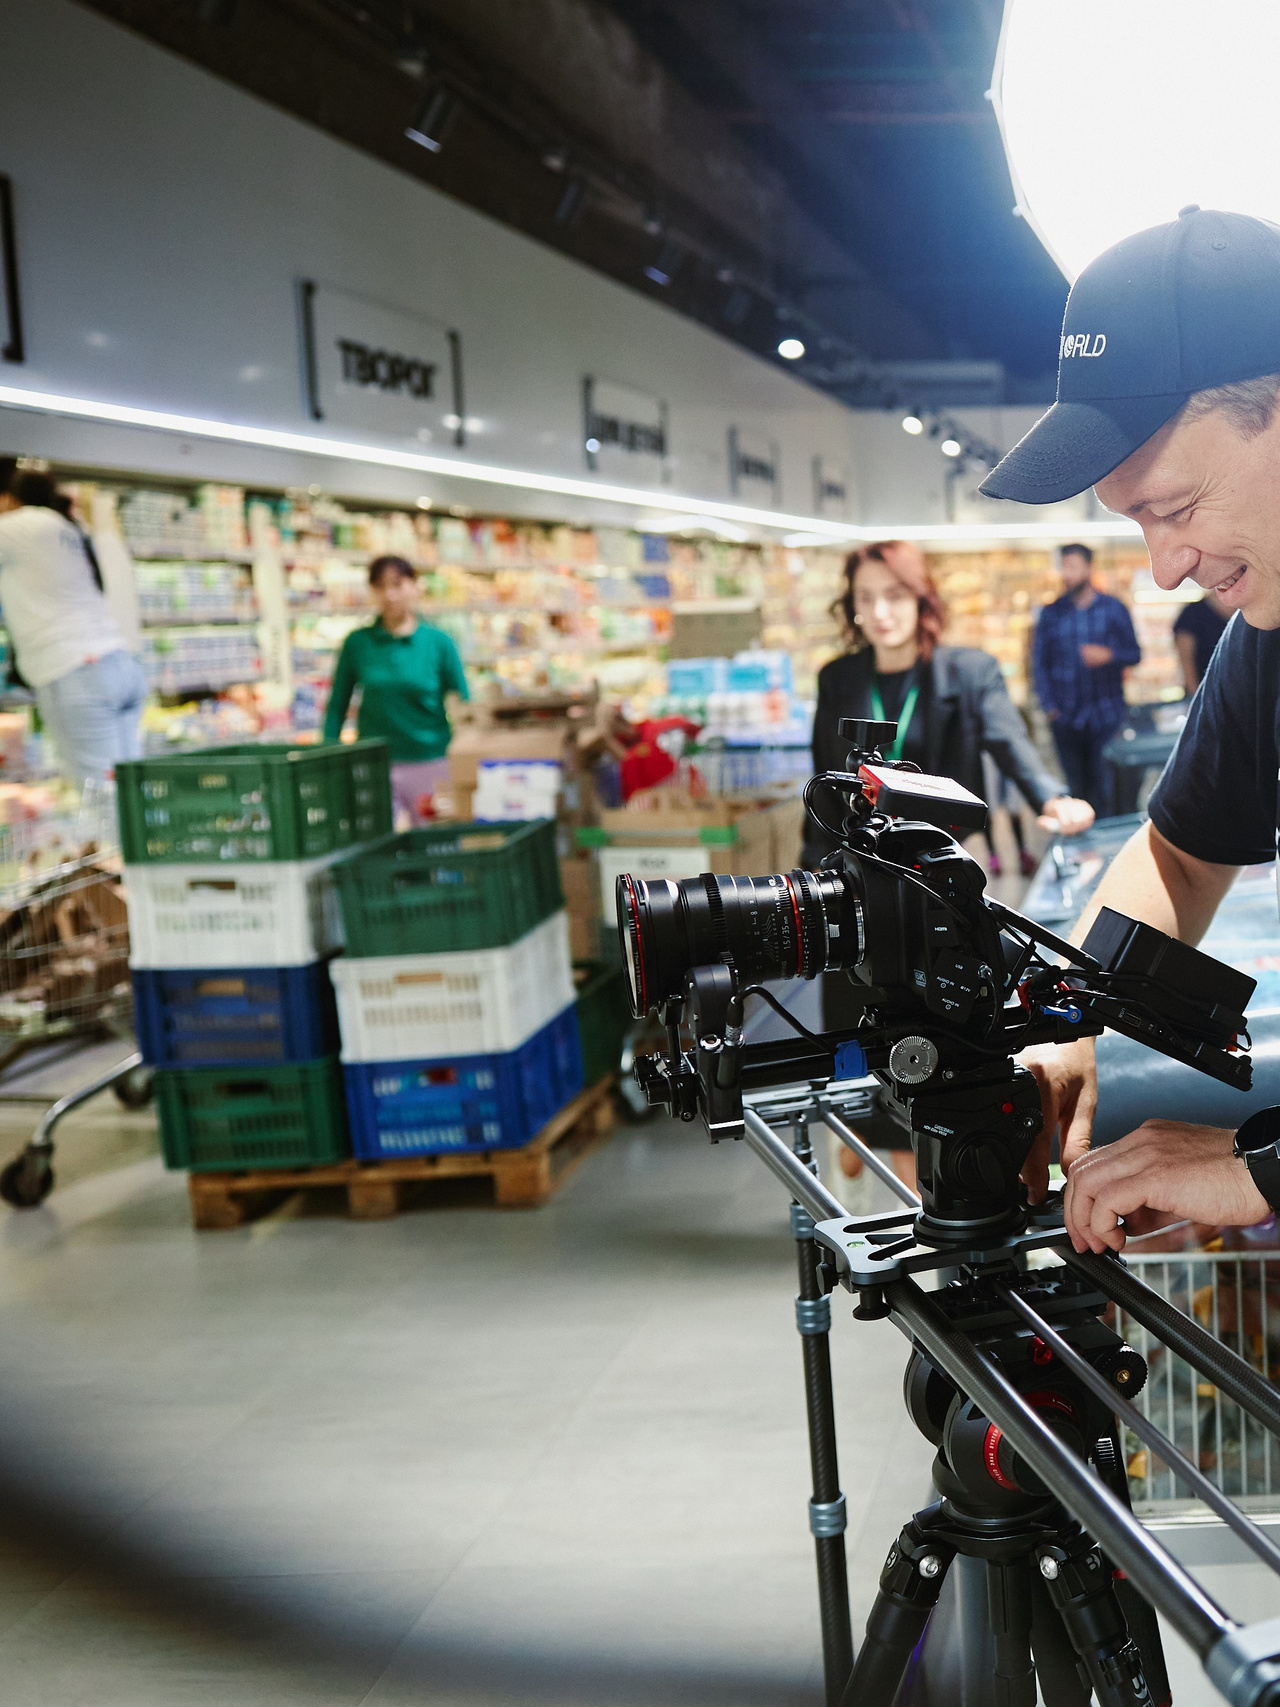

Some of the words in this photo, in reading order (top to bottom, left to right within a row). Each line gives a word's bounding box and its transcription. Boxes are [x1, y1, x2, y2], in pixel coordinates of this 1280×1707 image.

[1060, 333, 1106, 358] ORLD
[988, 1428, 999, 1449] SYSTEM
[988, 1452, 996, 1466] DRAG
[992, 1468, 1003, 1481] FLUID
